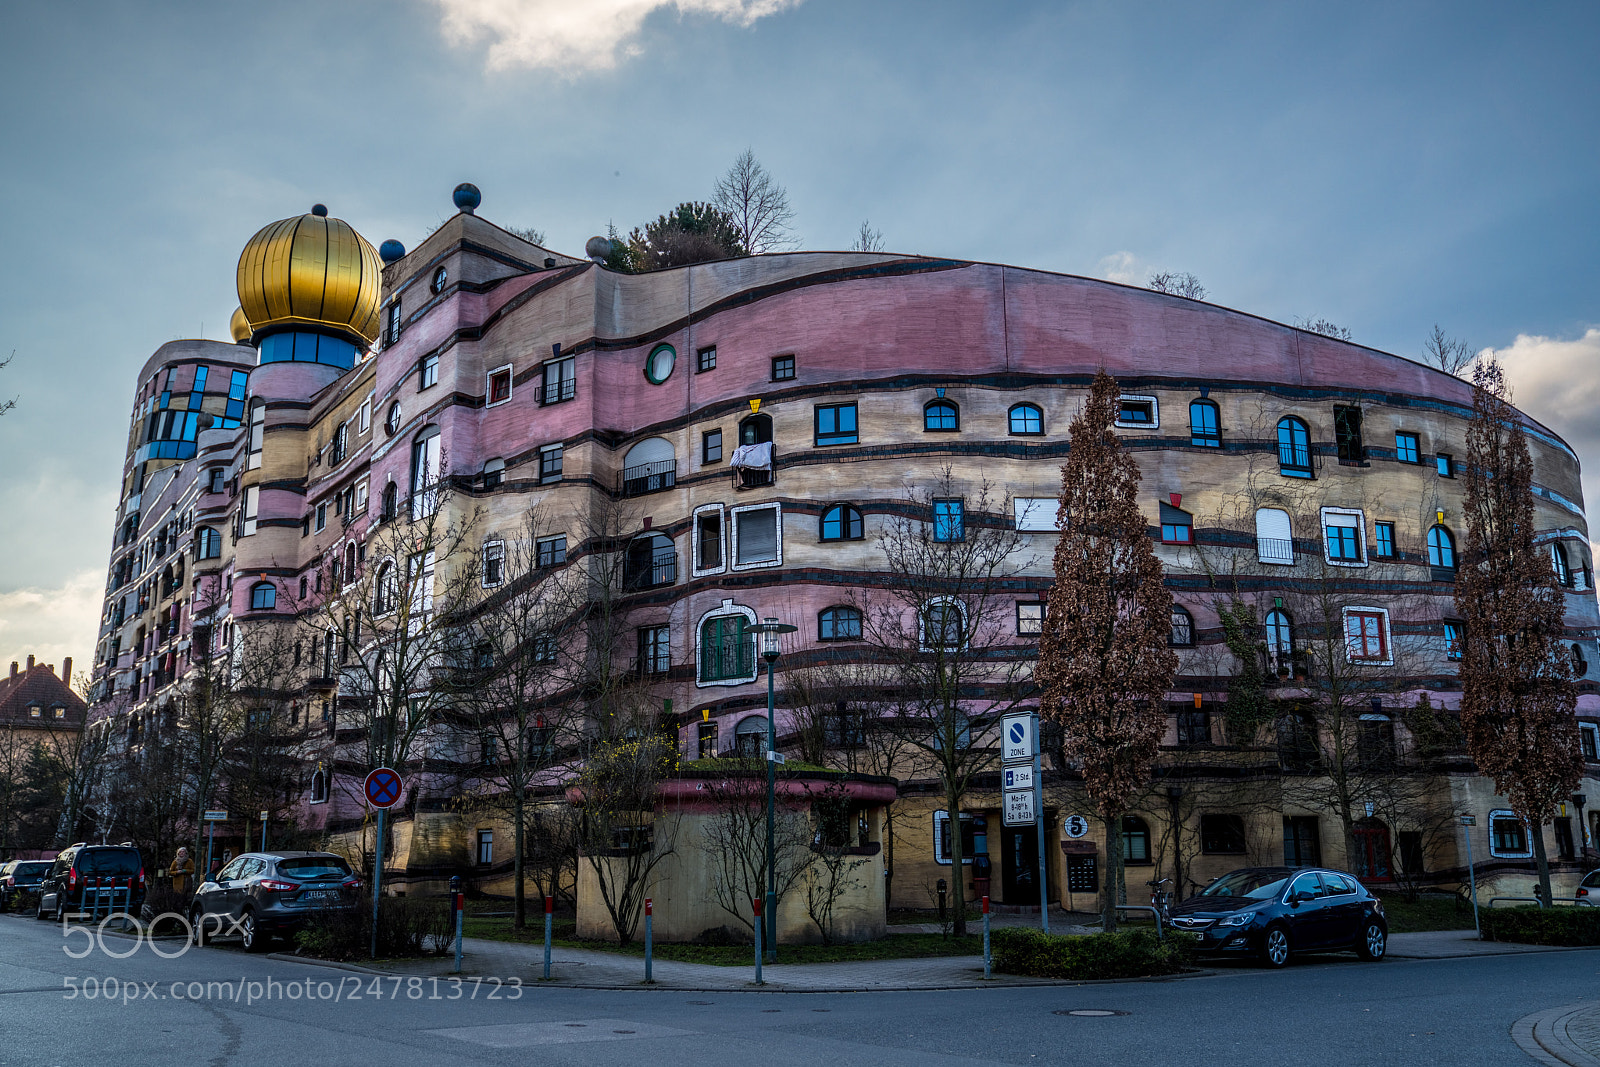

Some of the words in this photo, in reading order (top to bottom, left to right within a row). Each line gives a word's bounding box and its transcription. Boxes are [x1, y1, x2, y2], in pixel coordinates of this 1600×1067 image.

[1010, 748, 1025, 756] ZONE
[1011, 794, 1027, 803] Mo-Fr
[1007, 812, 1015, 820] Sa
[1071, 816, 1082, 835] 5
